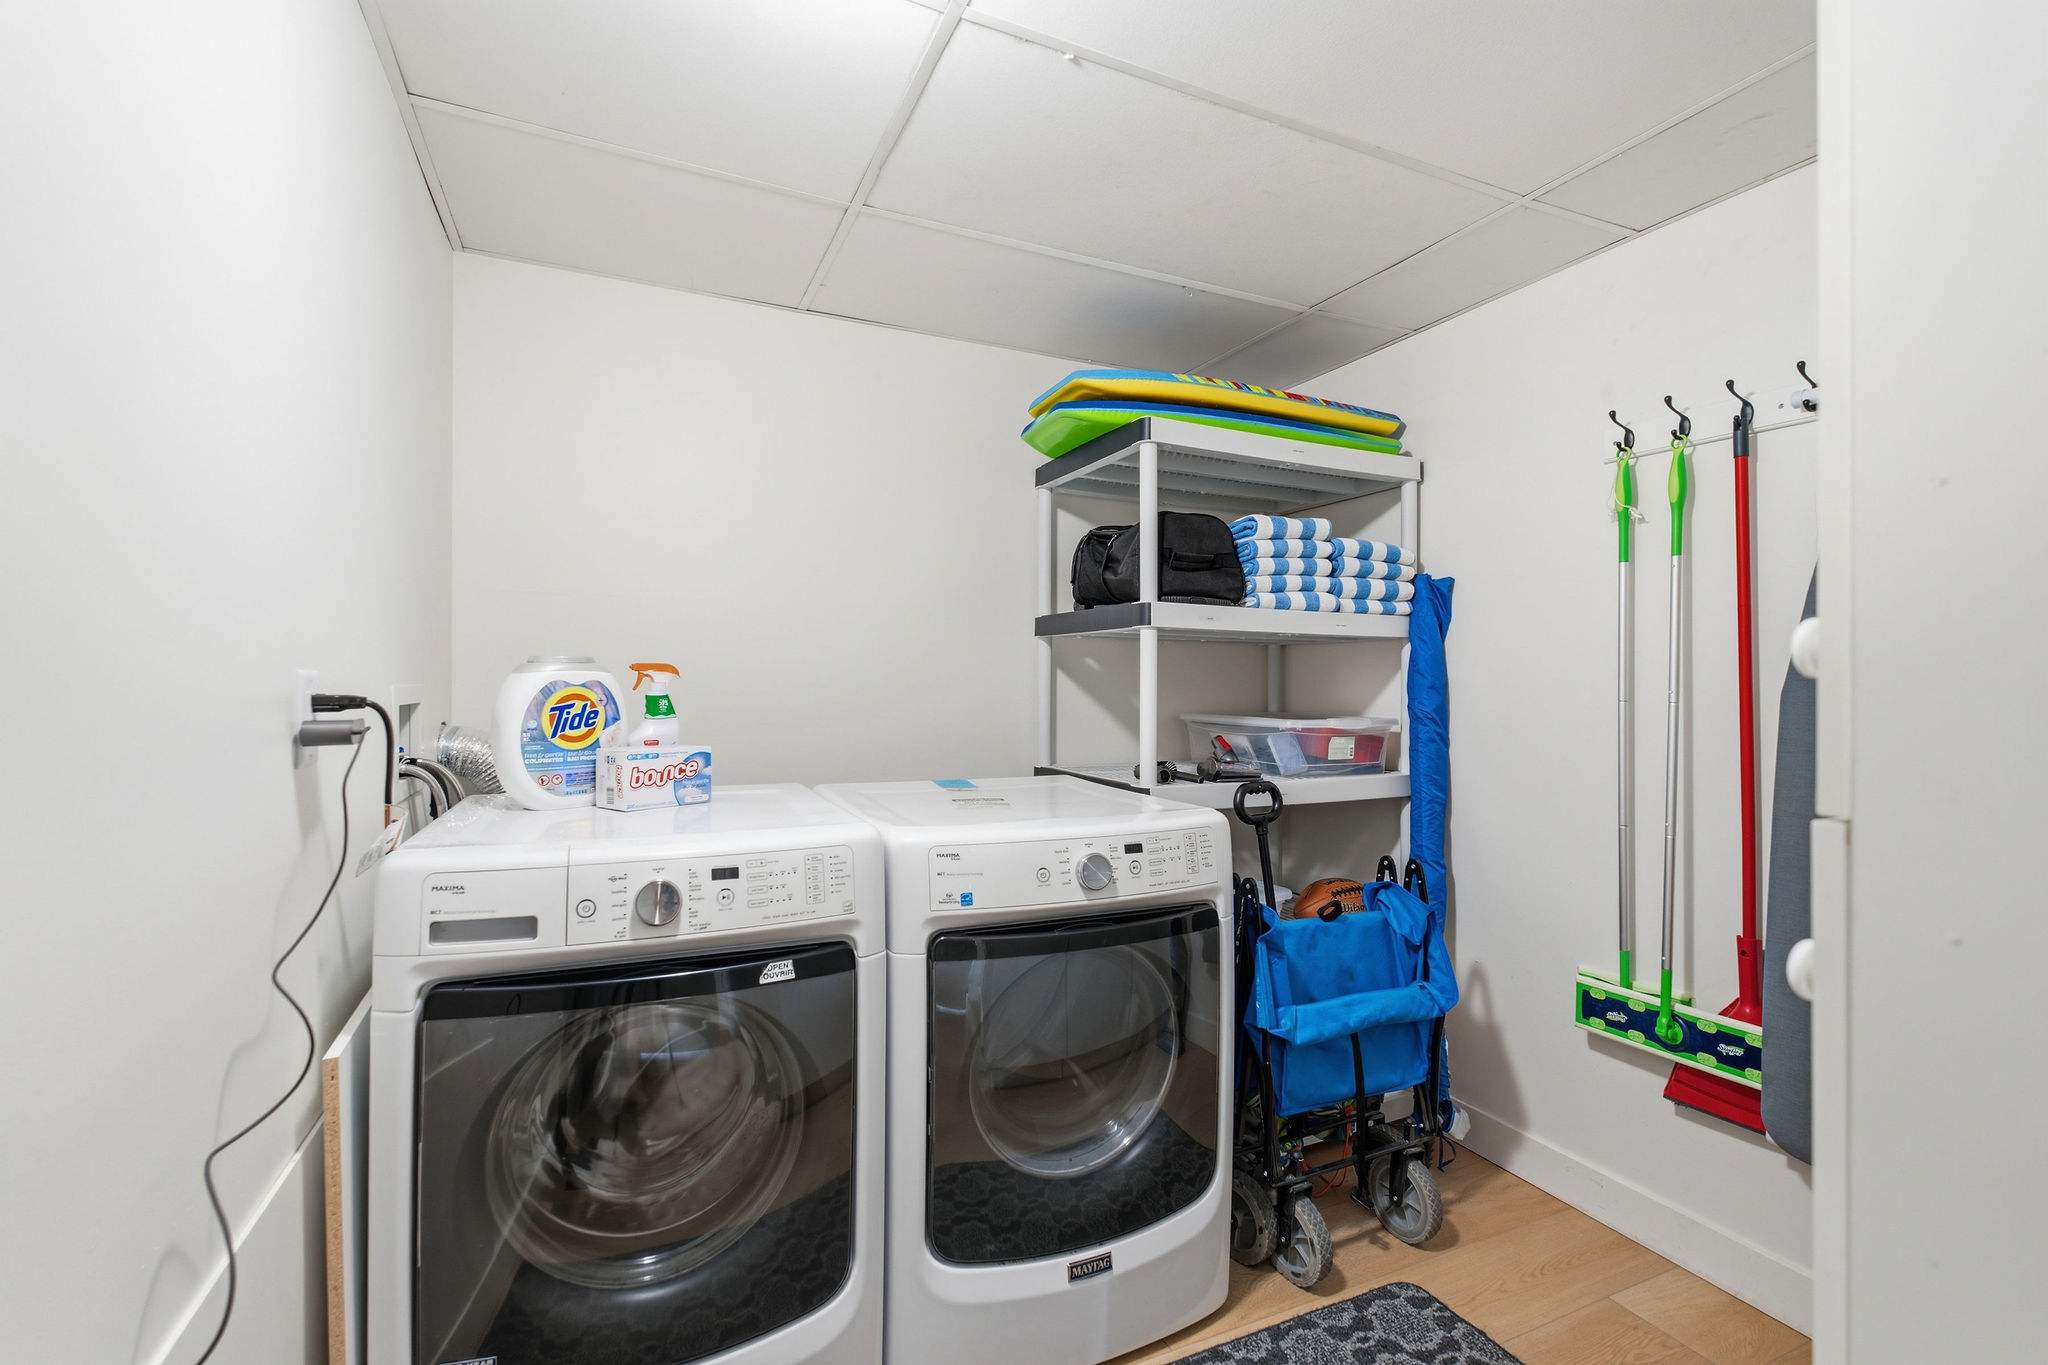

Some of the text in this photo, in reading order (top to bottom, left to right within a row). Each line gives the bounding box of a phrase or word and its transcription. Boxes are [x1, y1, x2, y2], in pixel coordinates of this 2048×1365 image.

[549, 702, 600, 739] Tide
[630, 760, 699, 789] bounce
[763, 969, 794, 980] OUVRIR
[768, 962, 789, 972] OPEN
[1071, 1258, 1111, 1278] MAYTAG
